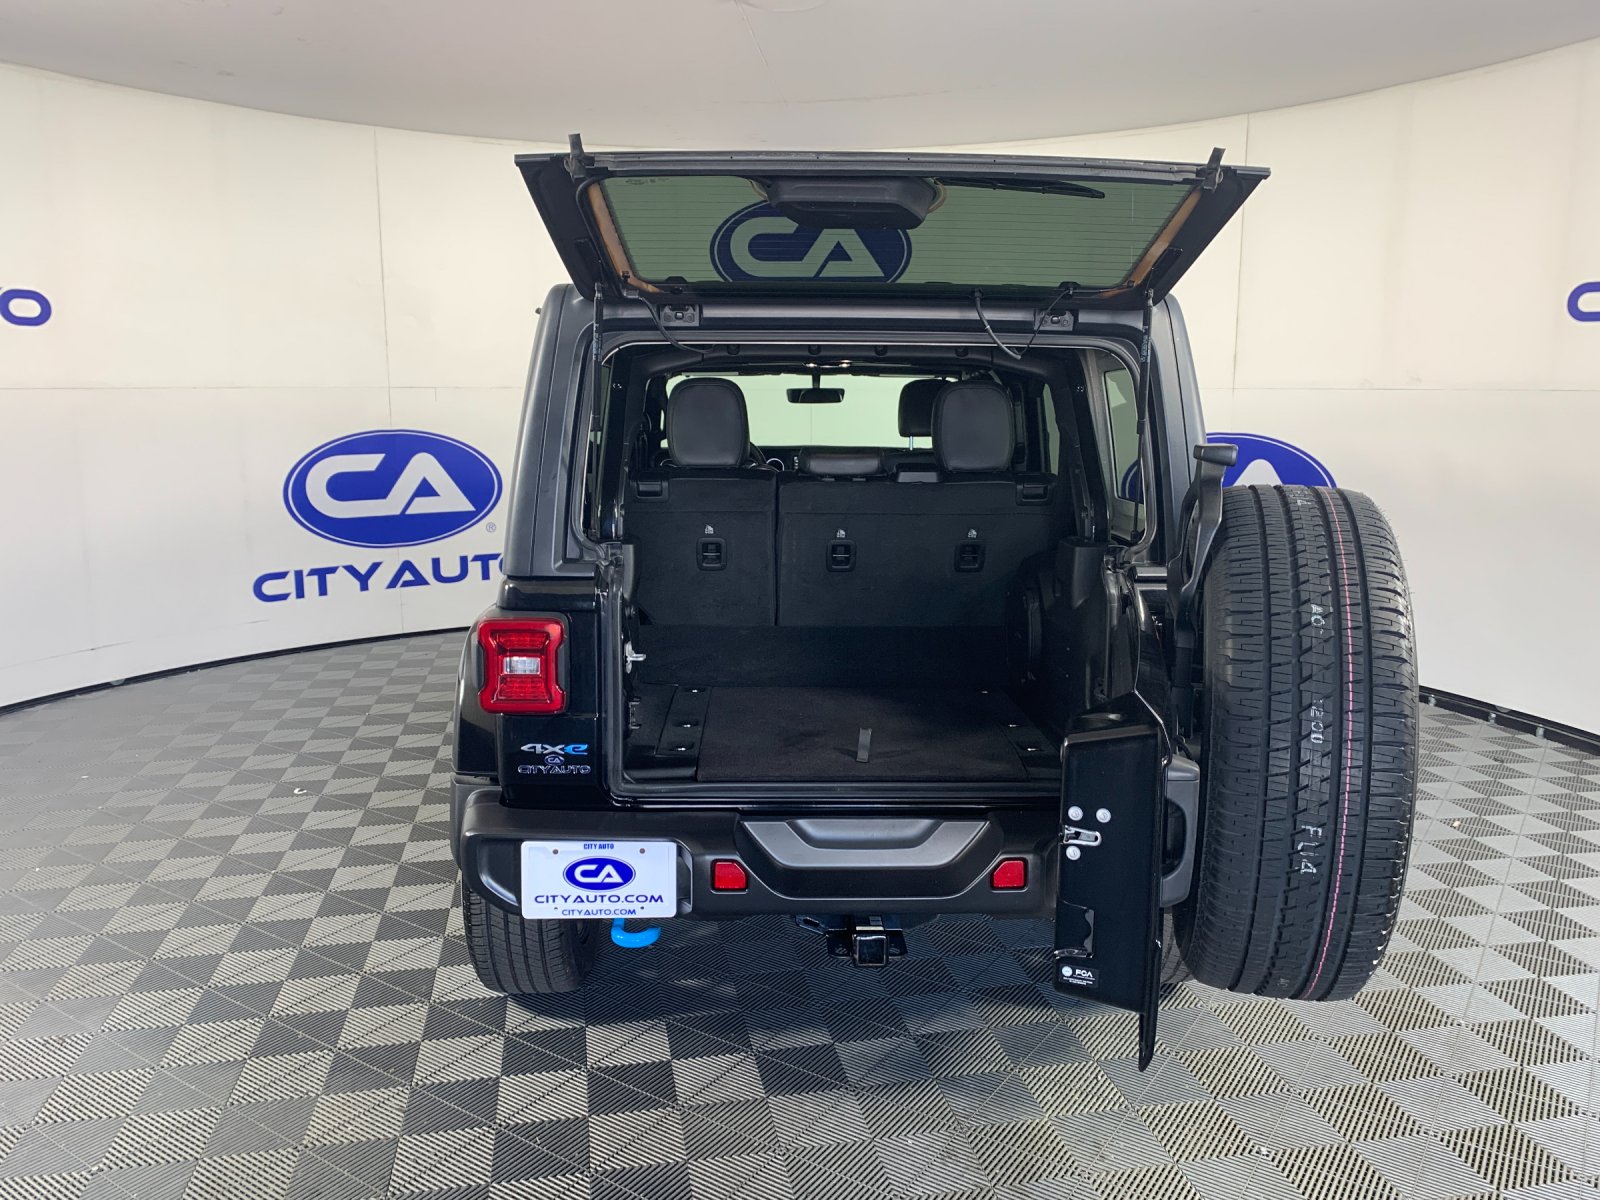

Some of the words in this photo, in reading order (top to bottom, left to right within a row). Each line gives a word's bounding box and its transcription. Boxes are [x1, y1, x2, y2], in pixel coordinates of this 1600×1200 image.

[729, 216, 886, 278] CA
[305, 451, 477, 519] CA
[573, 864, 625, 884] CA
[534, 894, 664, 904] CITYAUTO.COM
[561, 908, 637, 916] CITYAUTO.COM
